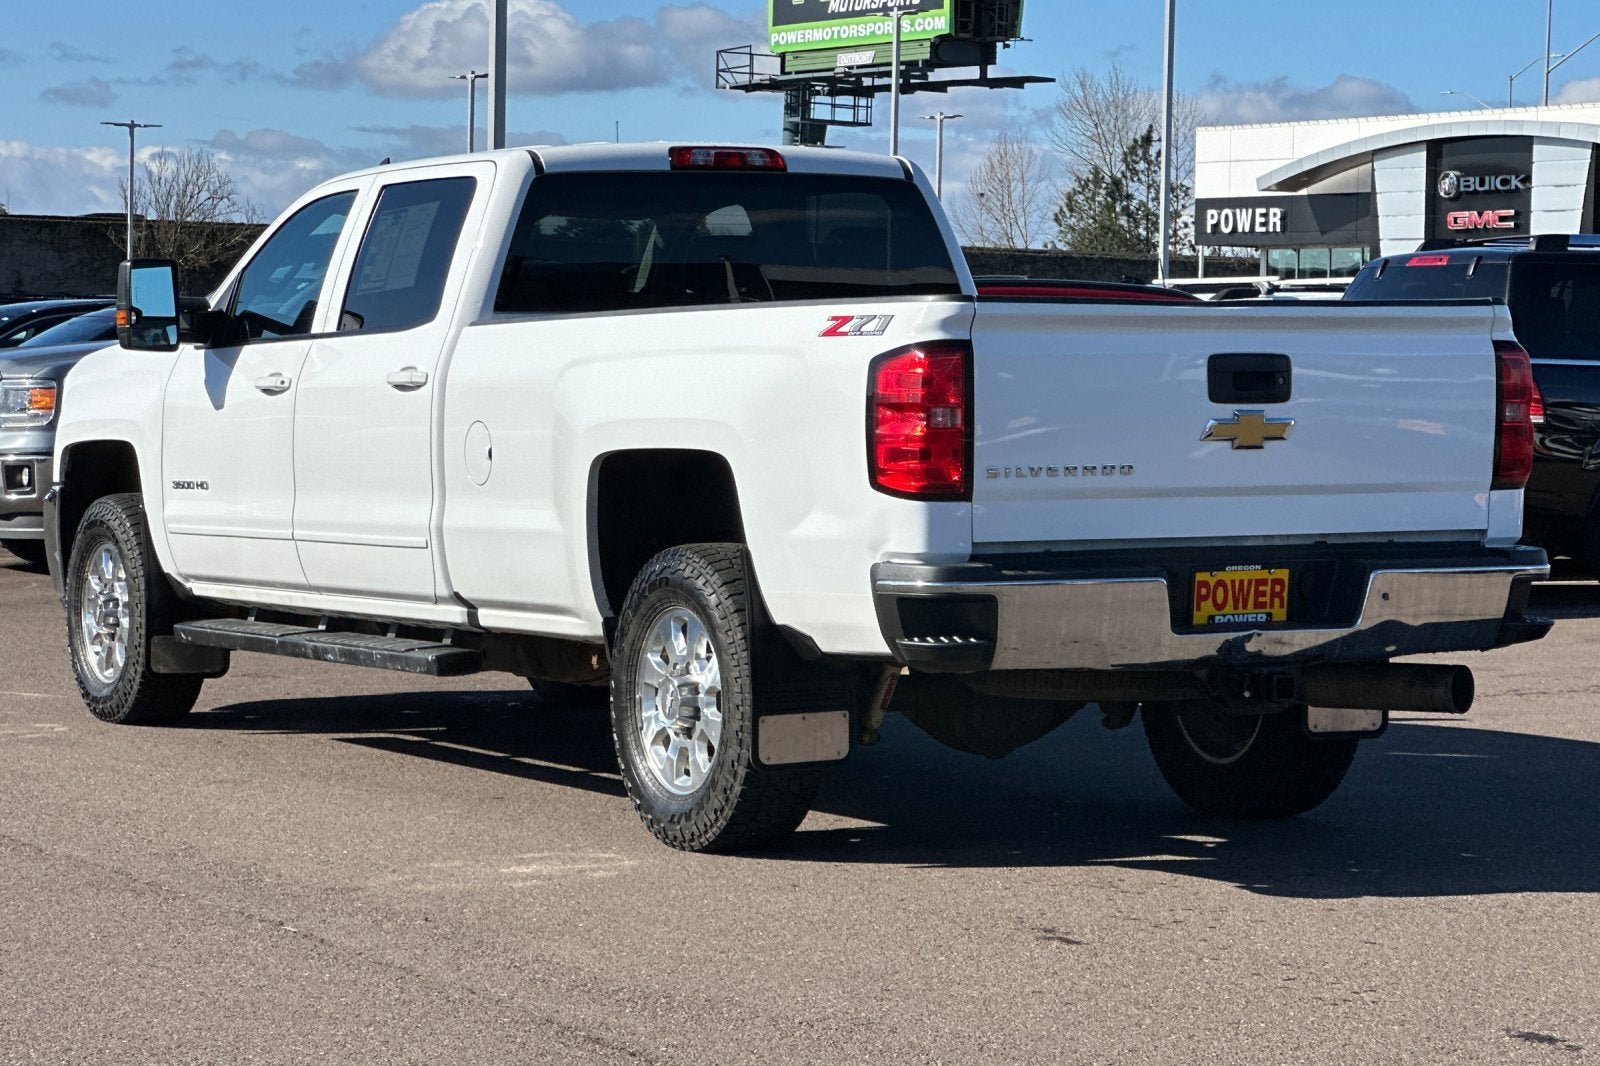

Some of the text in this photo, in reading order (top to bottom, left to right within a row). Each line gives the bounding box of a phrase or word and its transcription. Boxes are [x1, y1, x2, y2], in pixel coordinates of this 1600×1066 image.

[771, 16, 946, 46] POWERMOTORSPORS.COM
[1460, 174, 1526, 192] BUICK
[1207, 207, 1281, 234] POWER
[1447, 210, 1515, 230] GMC
[818, 315, 894, 337] Z71
[986, 464, 1134, 479] SILVERADO
[172, 480, 209, 490] 3500 HD
[1195, 577, 1286, 612] POWER
